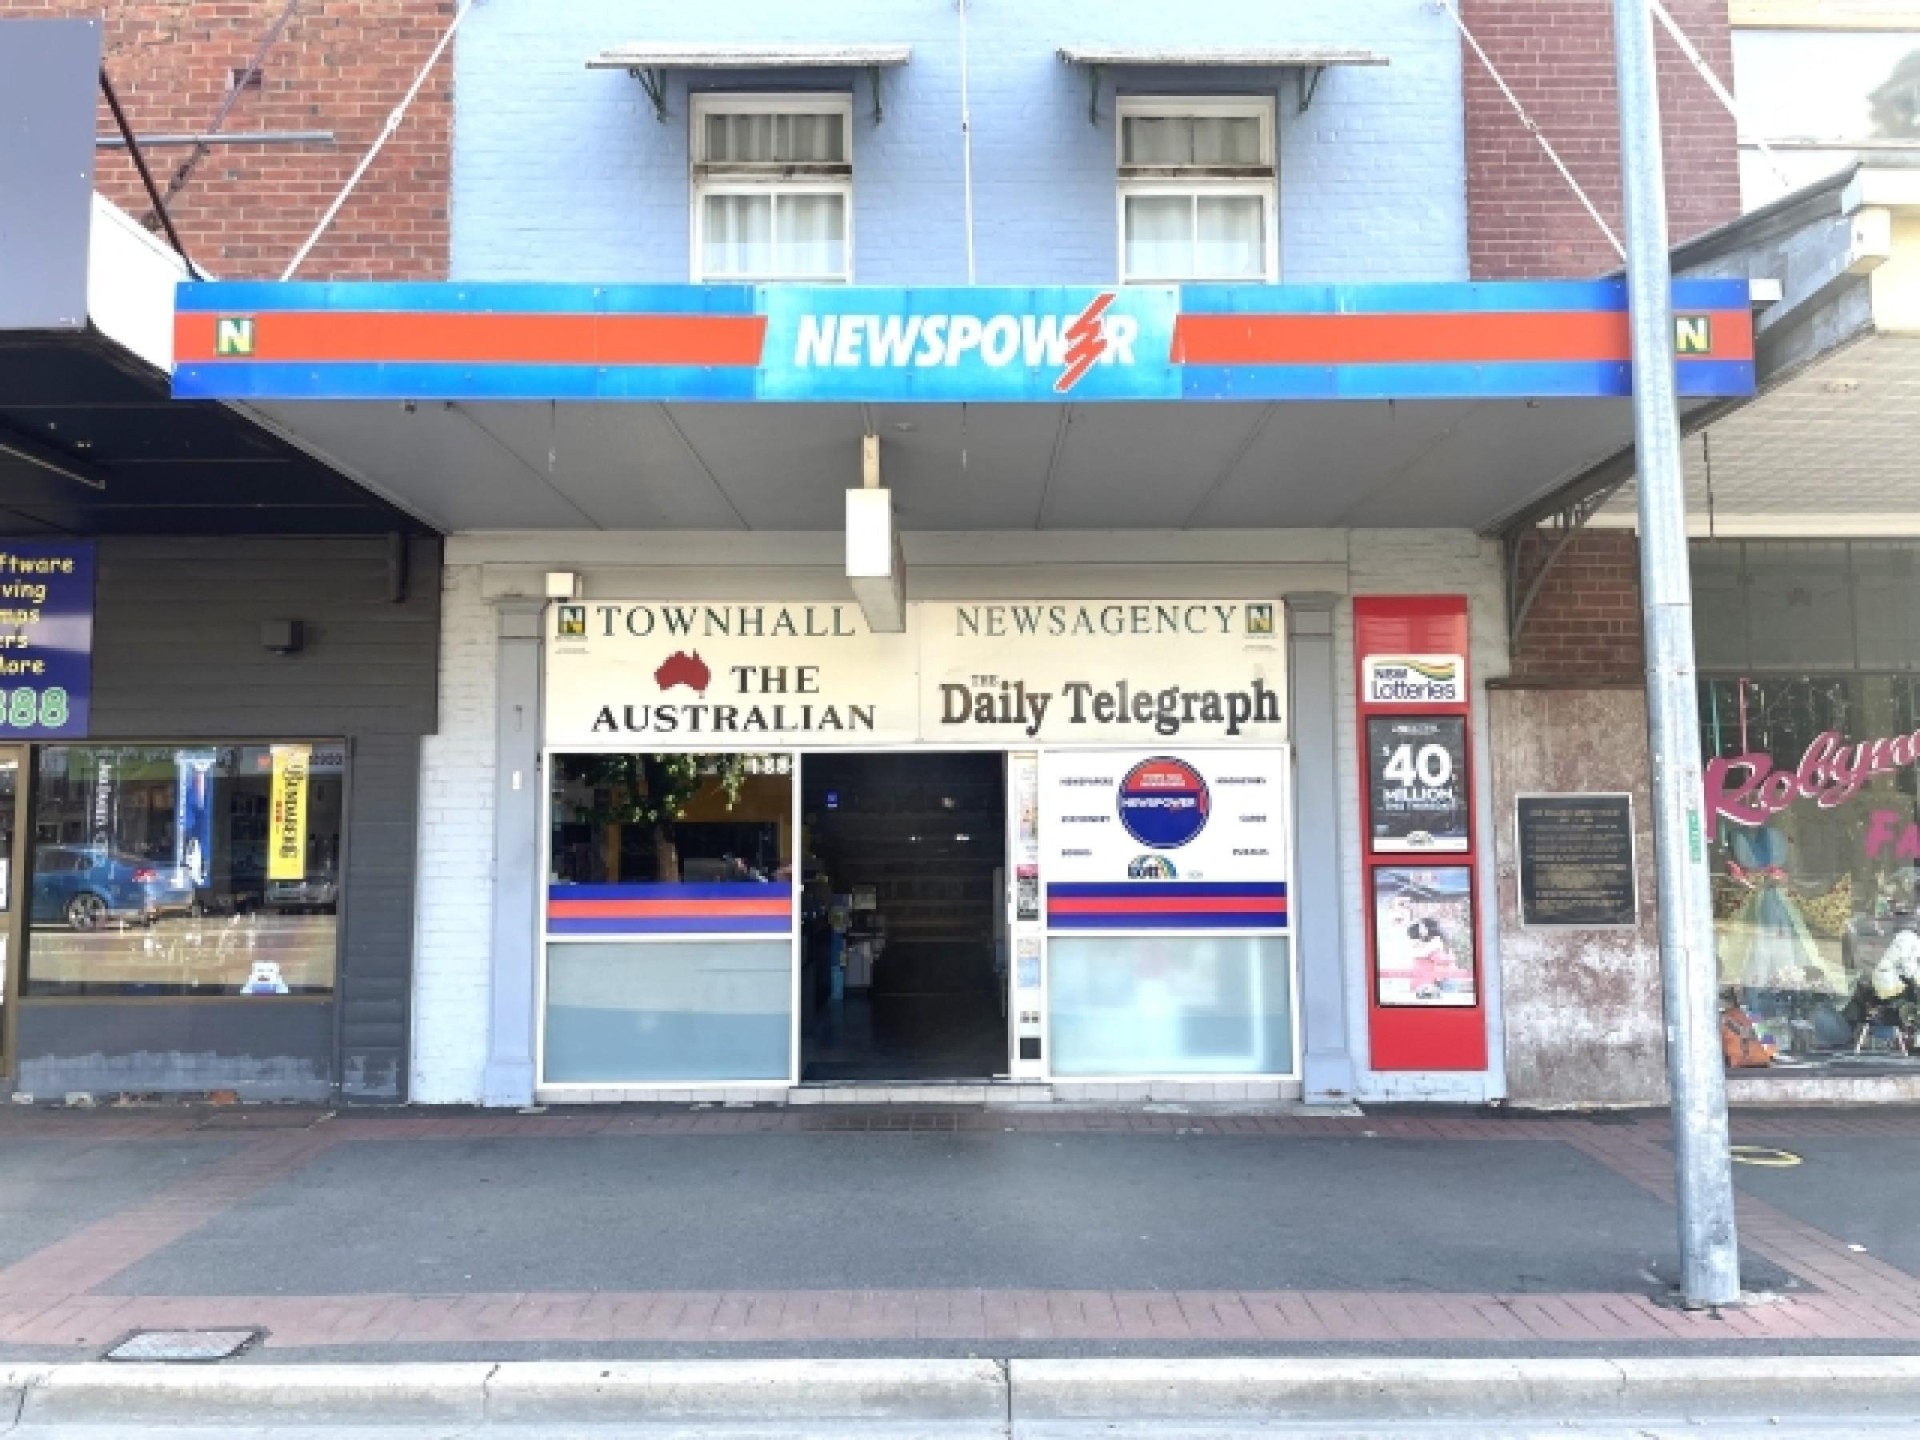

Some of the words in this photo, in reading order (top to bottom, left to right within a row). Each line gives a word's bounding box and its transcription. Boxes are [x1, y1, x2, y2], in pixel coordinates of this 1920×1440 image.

[219, 318, 251, 353] N
[794, 302, 1139, 384] NEWSPOWER
[1676, 317, 1707, 350] N
[597, 605, 856, 637] TOWNHALL
[955, 605, 1237, 636] NEWSAGENCY
[730, 666, 820, 693] THE
[971, 674, 999, 688] THE
[1371, 680, 1456, 700] Lotteries
[0, 687, 69, 728] 88
[591, 704, 876, 732] AUSTRALIAN
[939, 679, 1053, 737] Daily
[1062, 677, 1281, 736] Telegraph
[1704, 729, 1920, 843] Robyn
